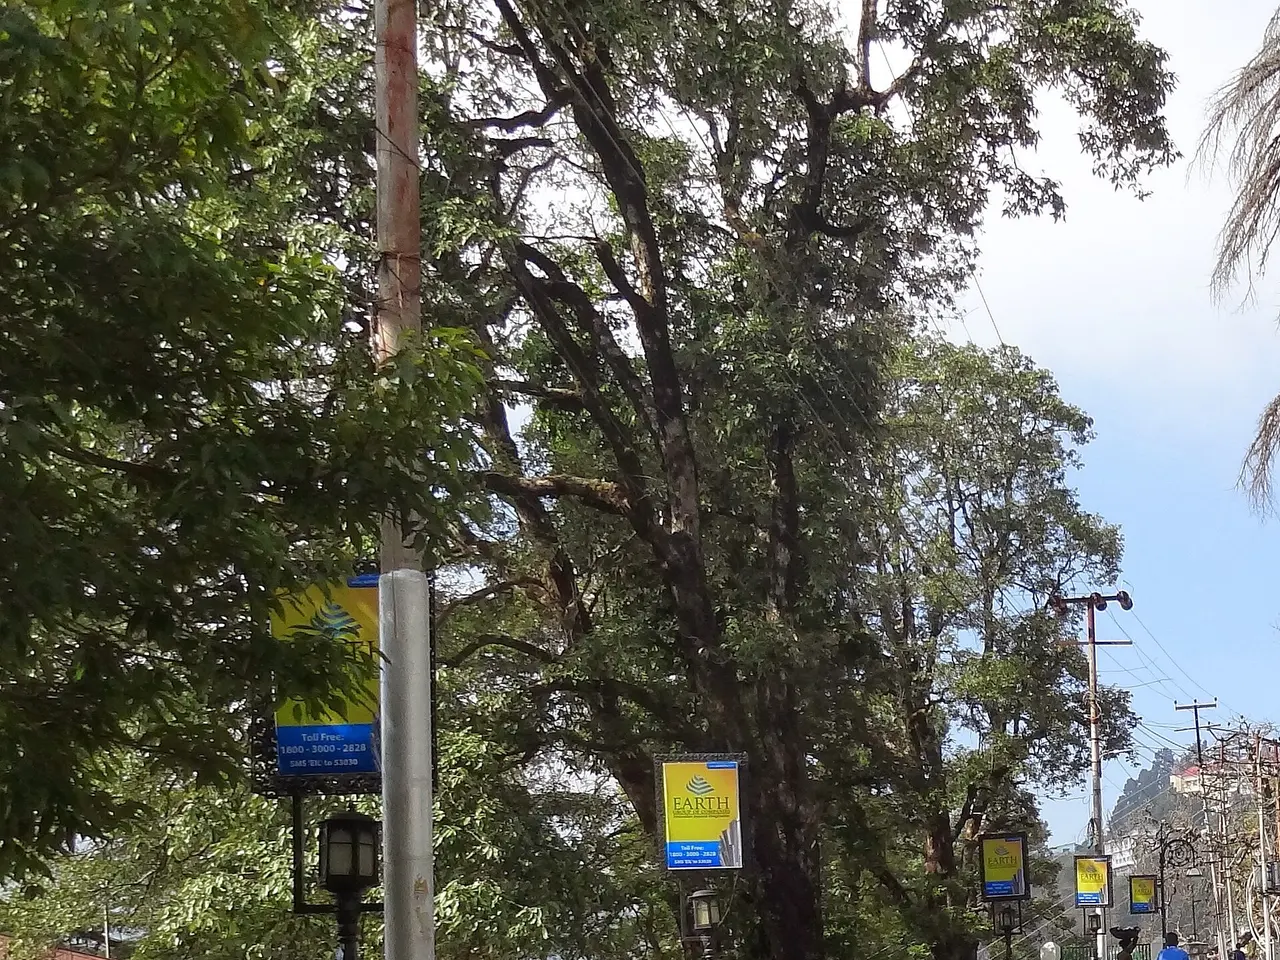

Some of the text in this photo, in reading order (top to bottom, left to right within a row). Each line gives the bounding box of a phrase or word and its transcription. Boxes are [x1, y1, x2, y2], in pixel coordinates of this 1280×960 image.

[301, 733, 319, 742] Toll
[674, 797, 730, 810] EARTH
[987, 856, 1018, 865] EARTH
[1080, 873, 1104, 881] EARTH
